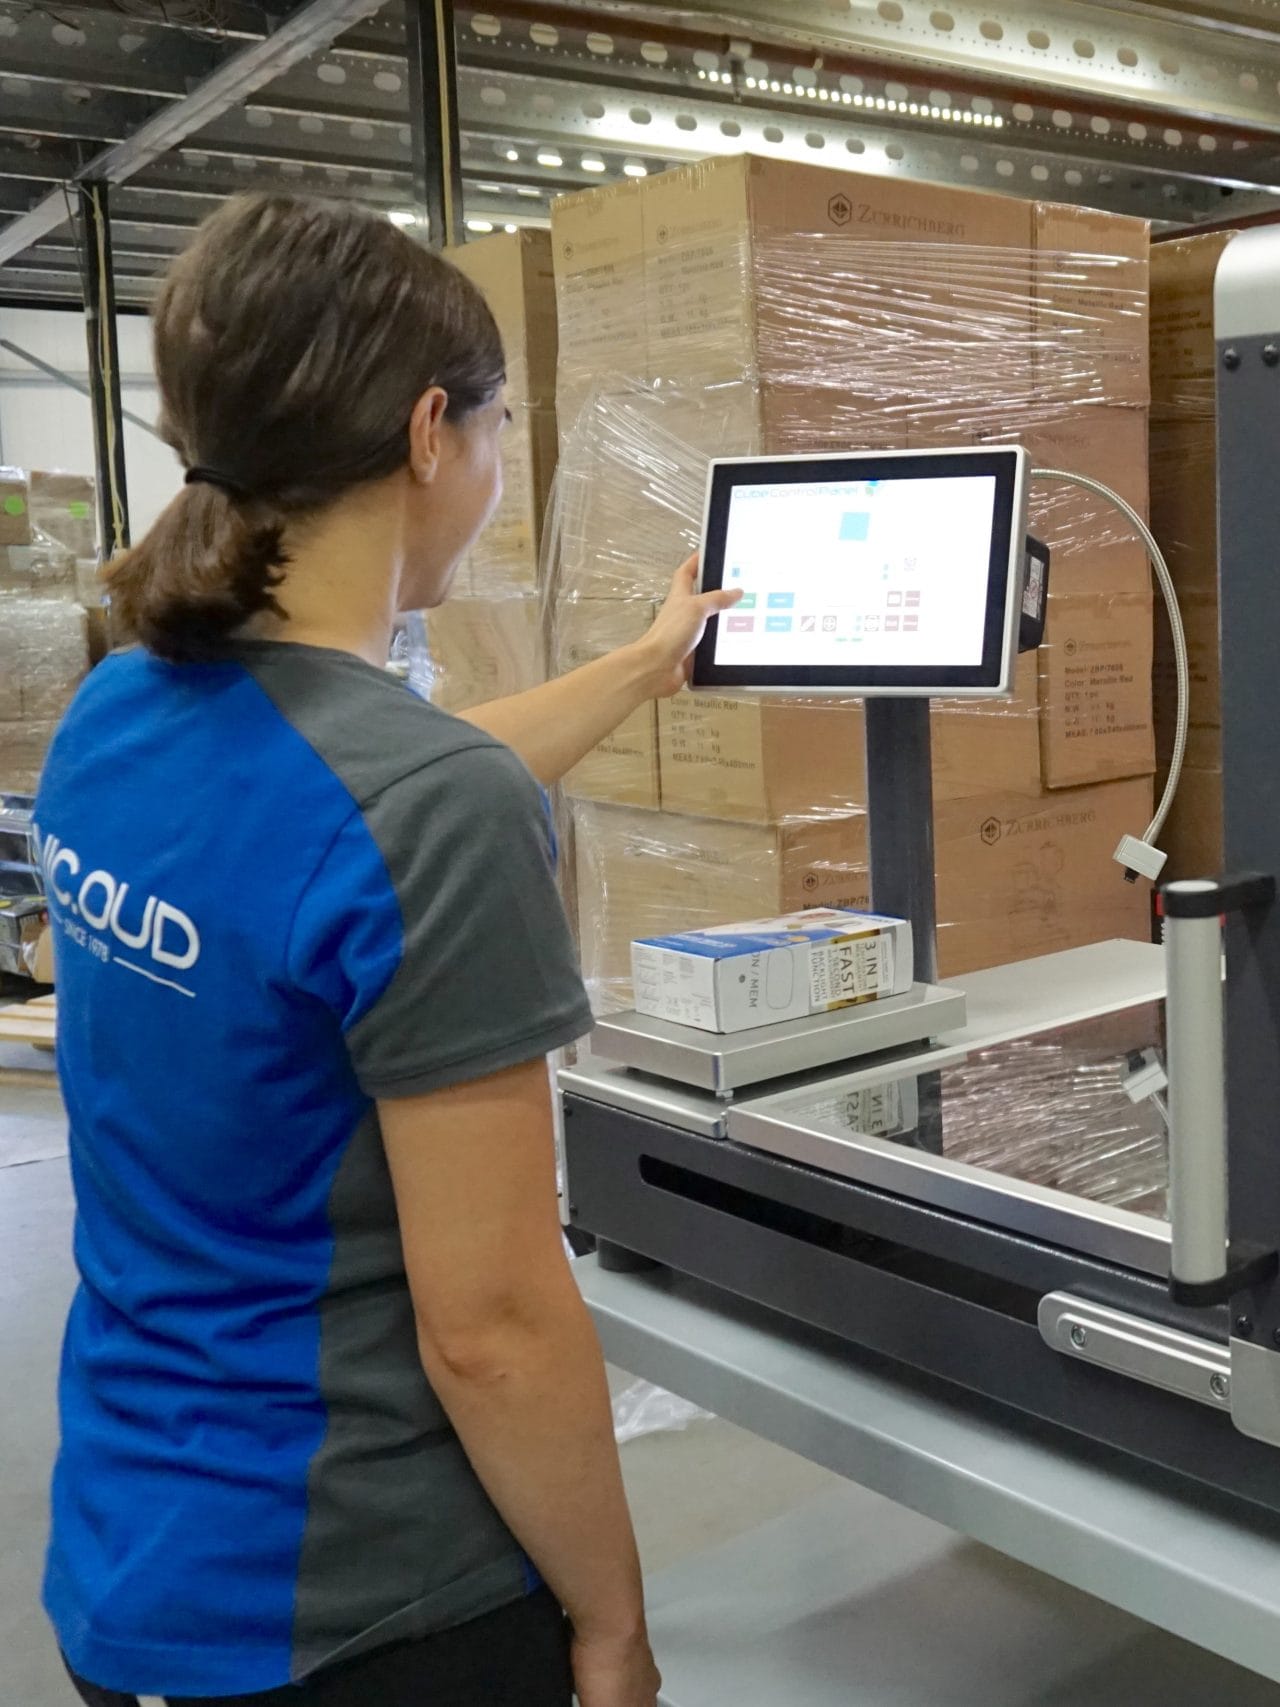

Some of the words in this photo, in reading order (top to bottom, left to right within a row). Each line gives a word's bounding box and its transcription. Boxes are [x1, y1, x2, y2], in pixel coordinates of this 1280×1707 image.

[723, 701, 738, 711] Red
[865, 941, 876, 951] 3
[810, 951, 820, 1002] FUNCTION
[817, 950, 827, 1000] BACKLIGHT
[831, 956, 841, 997] SECOND
[840, 946, 855, 993] FAST
[867, 956, 878, 976] IN
[748, 978, 759, 1008] MEM
